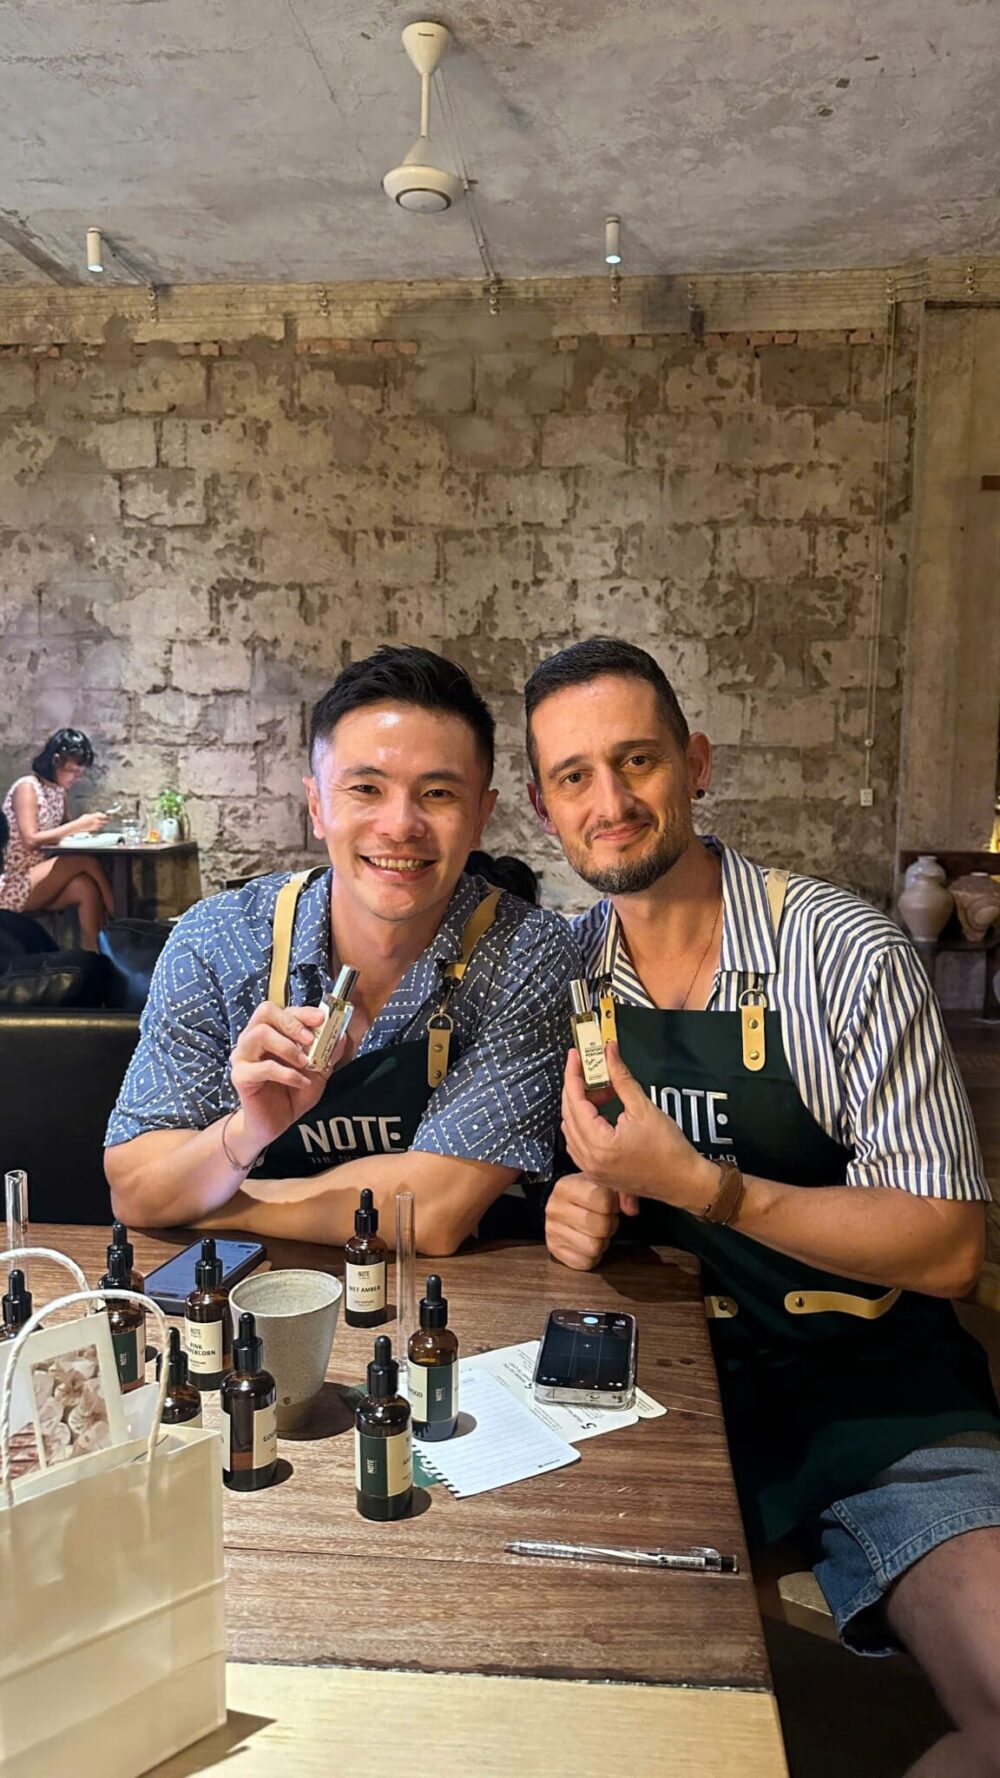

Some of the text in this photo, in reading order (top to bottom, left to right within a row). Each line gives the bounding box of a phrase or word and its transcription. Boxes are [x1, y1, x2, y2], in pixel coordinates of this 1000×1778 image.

[298, 1116, 406, 1153] NOTE
[581, 1422, 597, 1430] 5
[367, 1458, 375, 1474] NOTE
